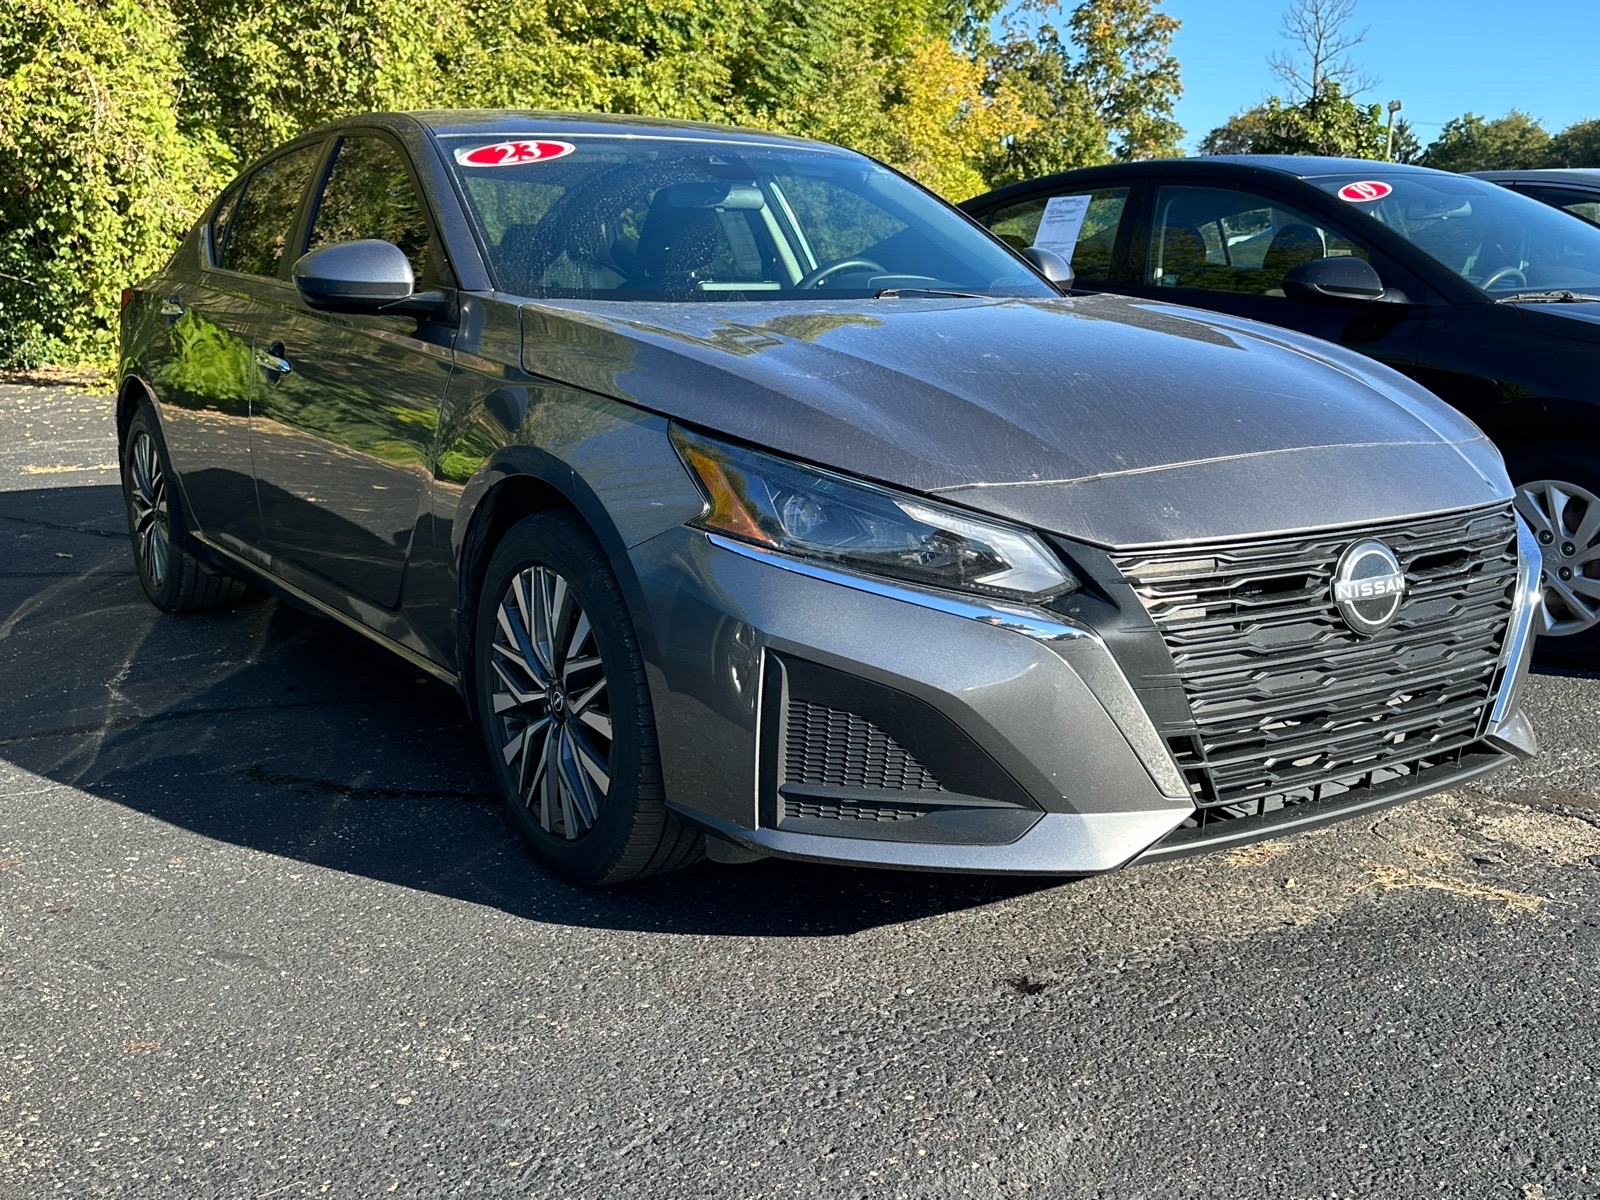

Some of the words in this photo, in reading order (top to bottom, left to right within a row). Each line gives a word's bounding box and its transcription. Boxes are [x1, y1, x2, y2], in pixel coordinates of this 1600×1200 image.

[494, 142, 541, 163] 23
[1349, 183, 1377, 199] 19
[1337, 576, 1405, 599] NISSAN
